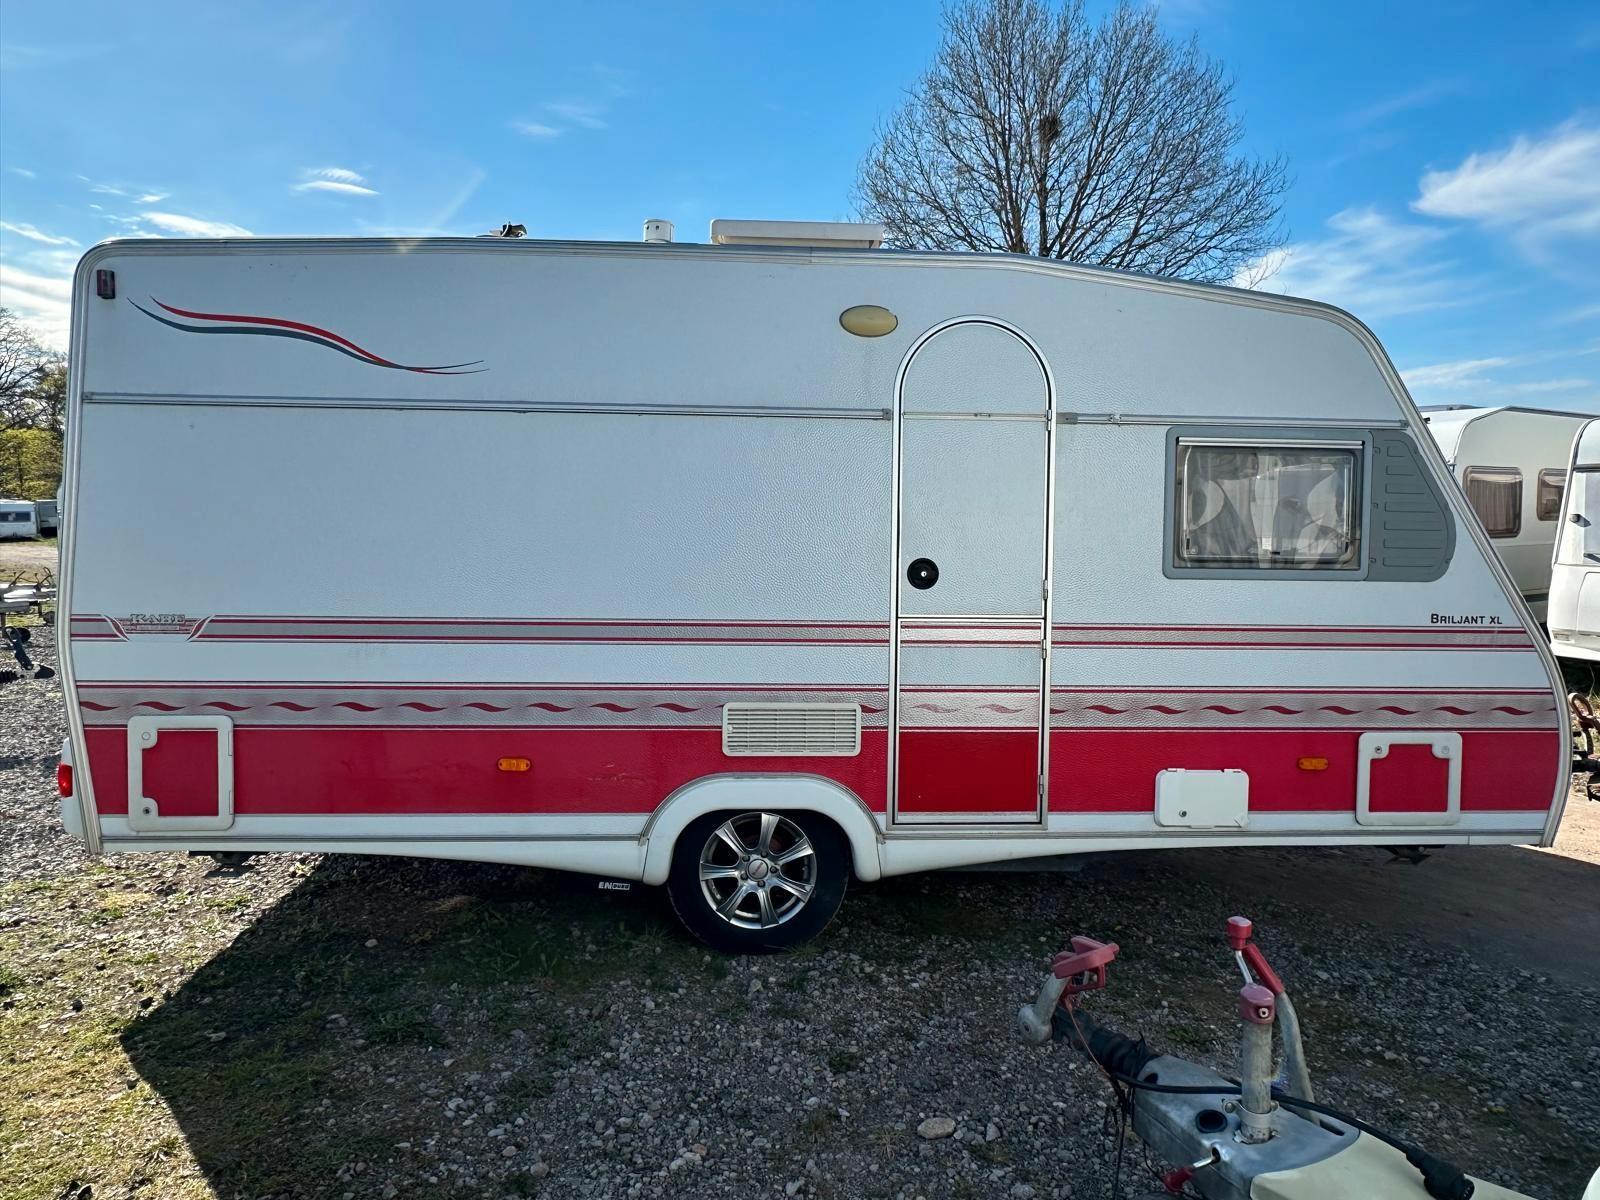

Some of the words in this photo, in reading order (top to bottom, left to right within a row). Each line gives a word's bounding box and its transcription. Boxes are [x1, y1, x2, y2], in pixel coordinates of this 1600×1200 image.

[130, 614, 185, 624] KABE
[1431, 613, 1486, 625] BRILJANT
[1489, 616, 1503, 625] XL
